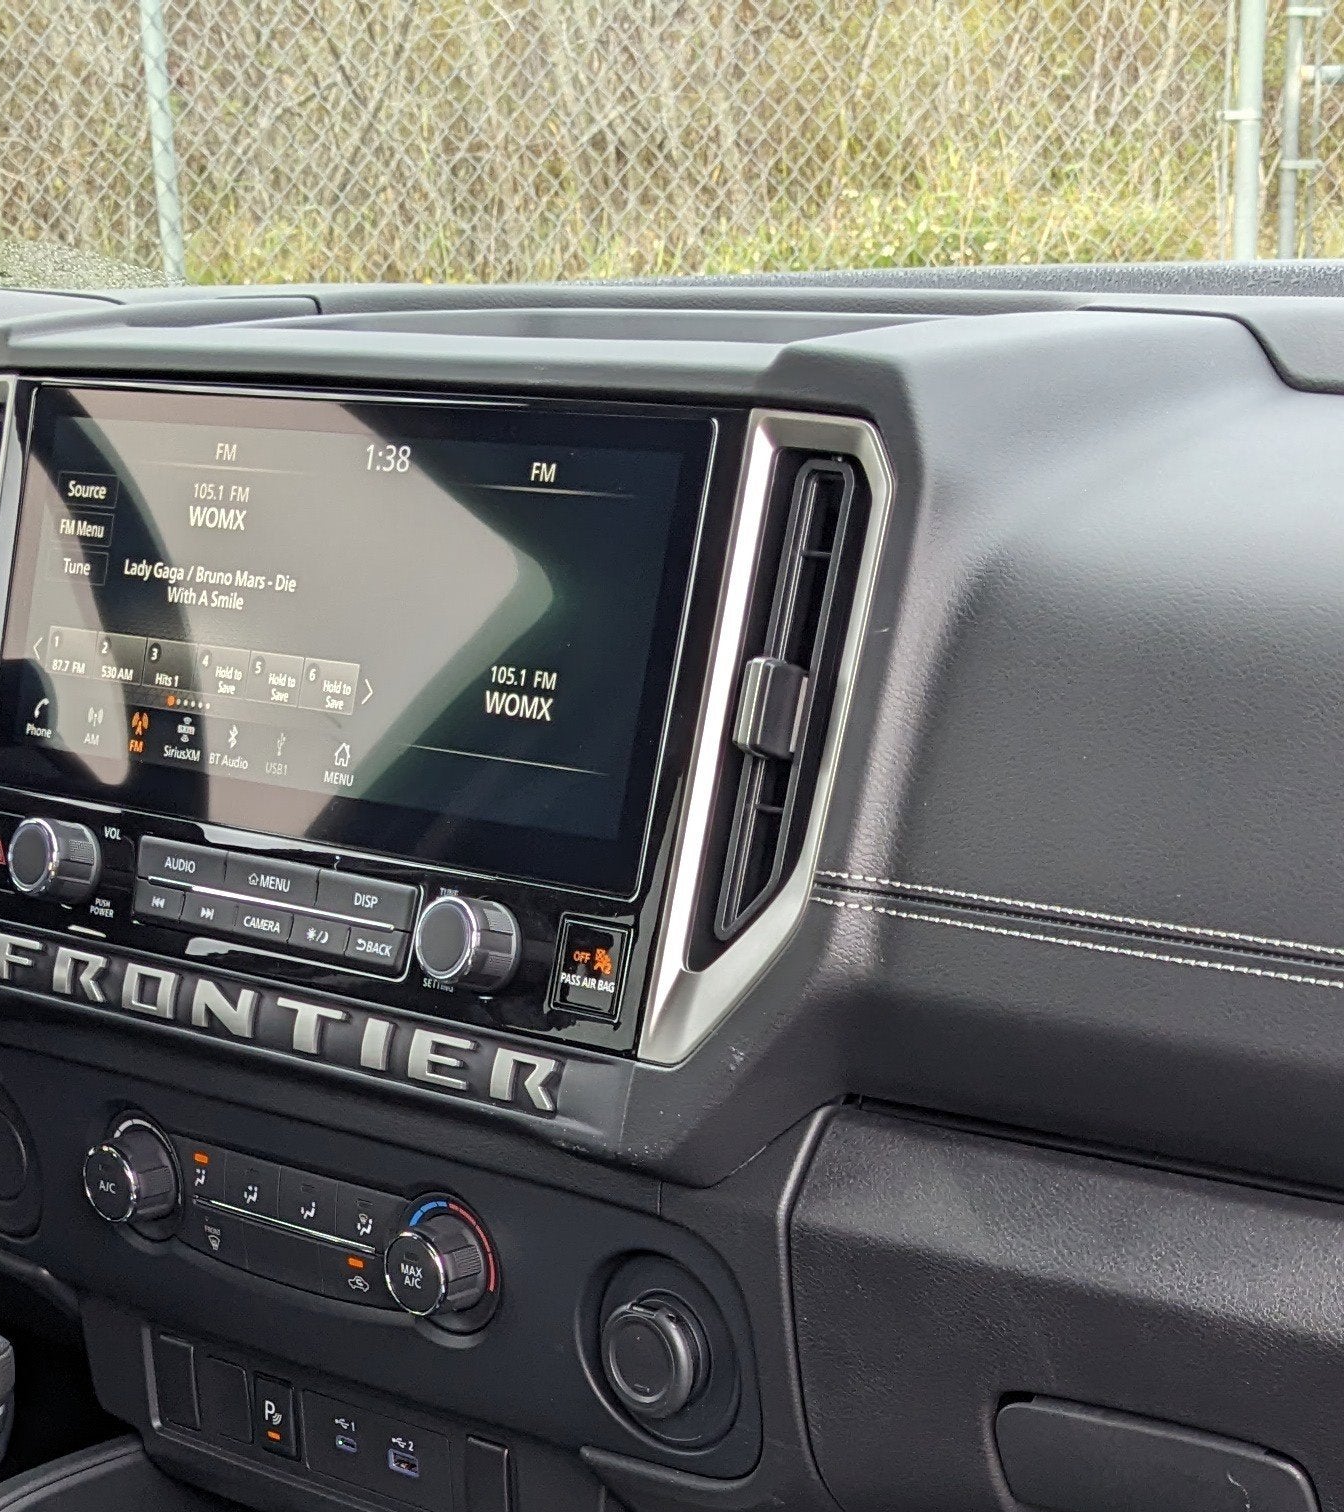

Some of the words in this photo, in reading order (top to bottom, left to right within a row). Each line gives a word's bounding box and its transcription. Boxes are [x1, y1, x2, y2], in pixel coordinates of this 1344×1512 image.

[216, 443, 238, 461] FM
[366, 444, 411, 473] 1:38
[530, 462, 557, 483] FM
[68, 480, 107, 499] Source
[193, 483, 224, 500] 105.1
[230, 486, 250, 502] FM
[189, 505, 247, 531] WOMX
[60, 518, 75, 535] FM
[77, 521, 105, 538] Menu
[63, 557, 91, 576] Tune
[124, 558, 153, 581] Lady
[154, 562, 184, 584] Gaga
[196, 568, 232, 586] Bruno
[235, 570, 266, 590] Mars
[274, 574, 297, 593] Die
[167, 586, 196, 605] With
[198, 590, 208, 606] A
[210, 590, 244, 610] Smile
[101, 642, 108, 654] 2
[150, 648, 158, 661] 3
[71, 661, 86, 675] FM
[202, 655, 209, 667] 4
[255, 661, 262, 674] 5
[101, 665, 117, 680] 530
[117, 668, 134, 682] AM
[155, 672, 172, 686] Hits
[215, 666, 232, 679] Hold
[233, 668, 243, 681] to
[268, 672, 286, 687] Hold
[287, 675, 297, 688] to
[309, 669, 316, 682] 6
[491, 665, 526, 687] 105.1
[533, 670, 558, 691] FM
[217, 681, 236, 695] Save
[271, 688, 289, 702] Save
[322, 679, 341, 694] Hold
[342, 683, 352, 696] to
[325, 695, 344, 711] Save
[485, 690, 554, 722] WOMX
[25, 722, 53, 739] Phone
[83, 733, 100, 746] AM
[128, 740, 144, 753] FM
[163, 745, 201, 762] SiriusXM
[209, 752, 222, 766] BT
[222, 755, 249, 770] Audio
[323, 770, 355, 787] MENU
[104, 825, 122, 841] VOL
[164, 856, 196, 874] AUDIO
[259, 874, 291, 893] MENU
[354, 892, 379, 909] DISP
[89, 905, 114, 919] POWER
[243, 915, 281, 934] CAMERA
[367, 941, 393, 957] BACK
[573, 950, 591, 964] OFF
[560, 972, 581, 986] PASS
[581, 976, 596, 990] AIR
[597, 979, 616, 994] BAG
[99, 1180, 116, 1194] A/C
[400, 1262, 423, 1279] MAX
[404, 1275, 422, 1290] A/C
[264, 1400, 276, 1421] P
[408, 1441, 415, 1452] 2
